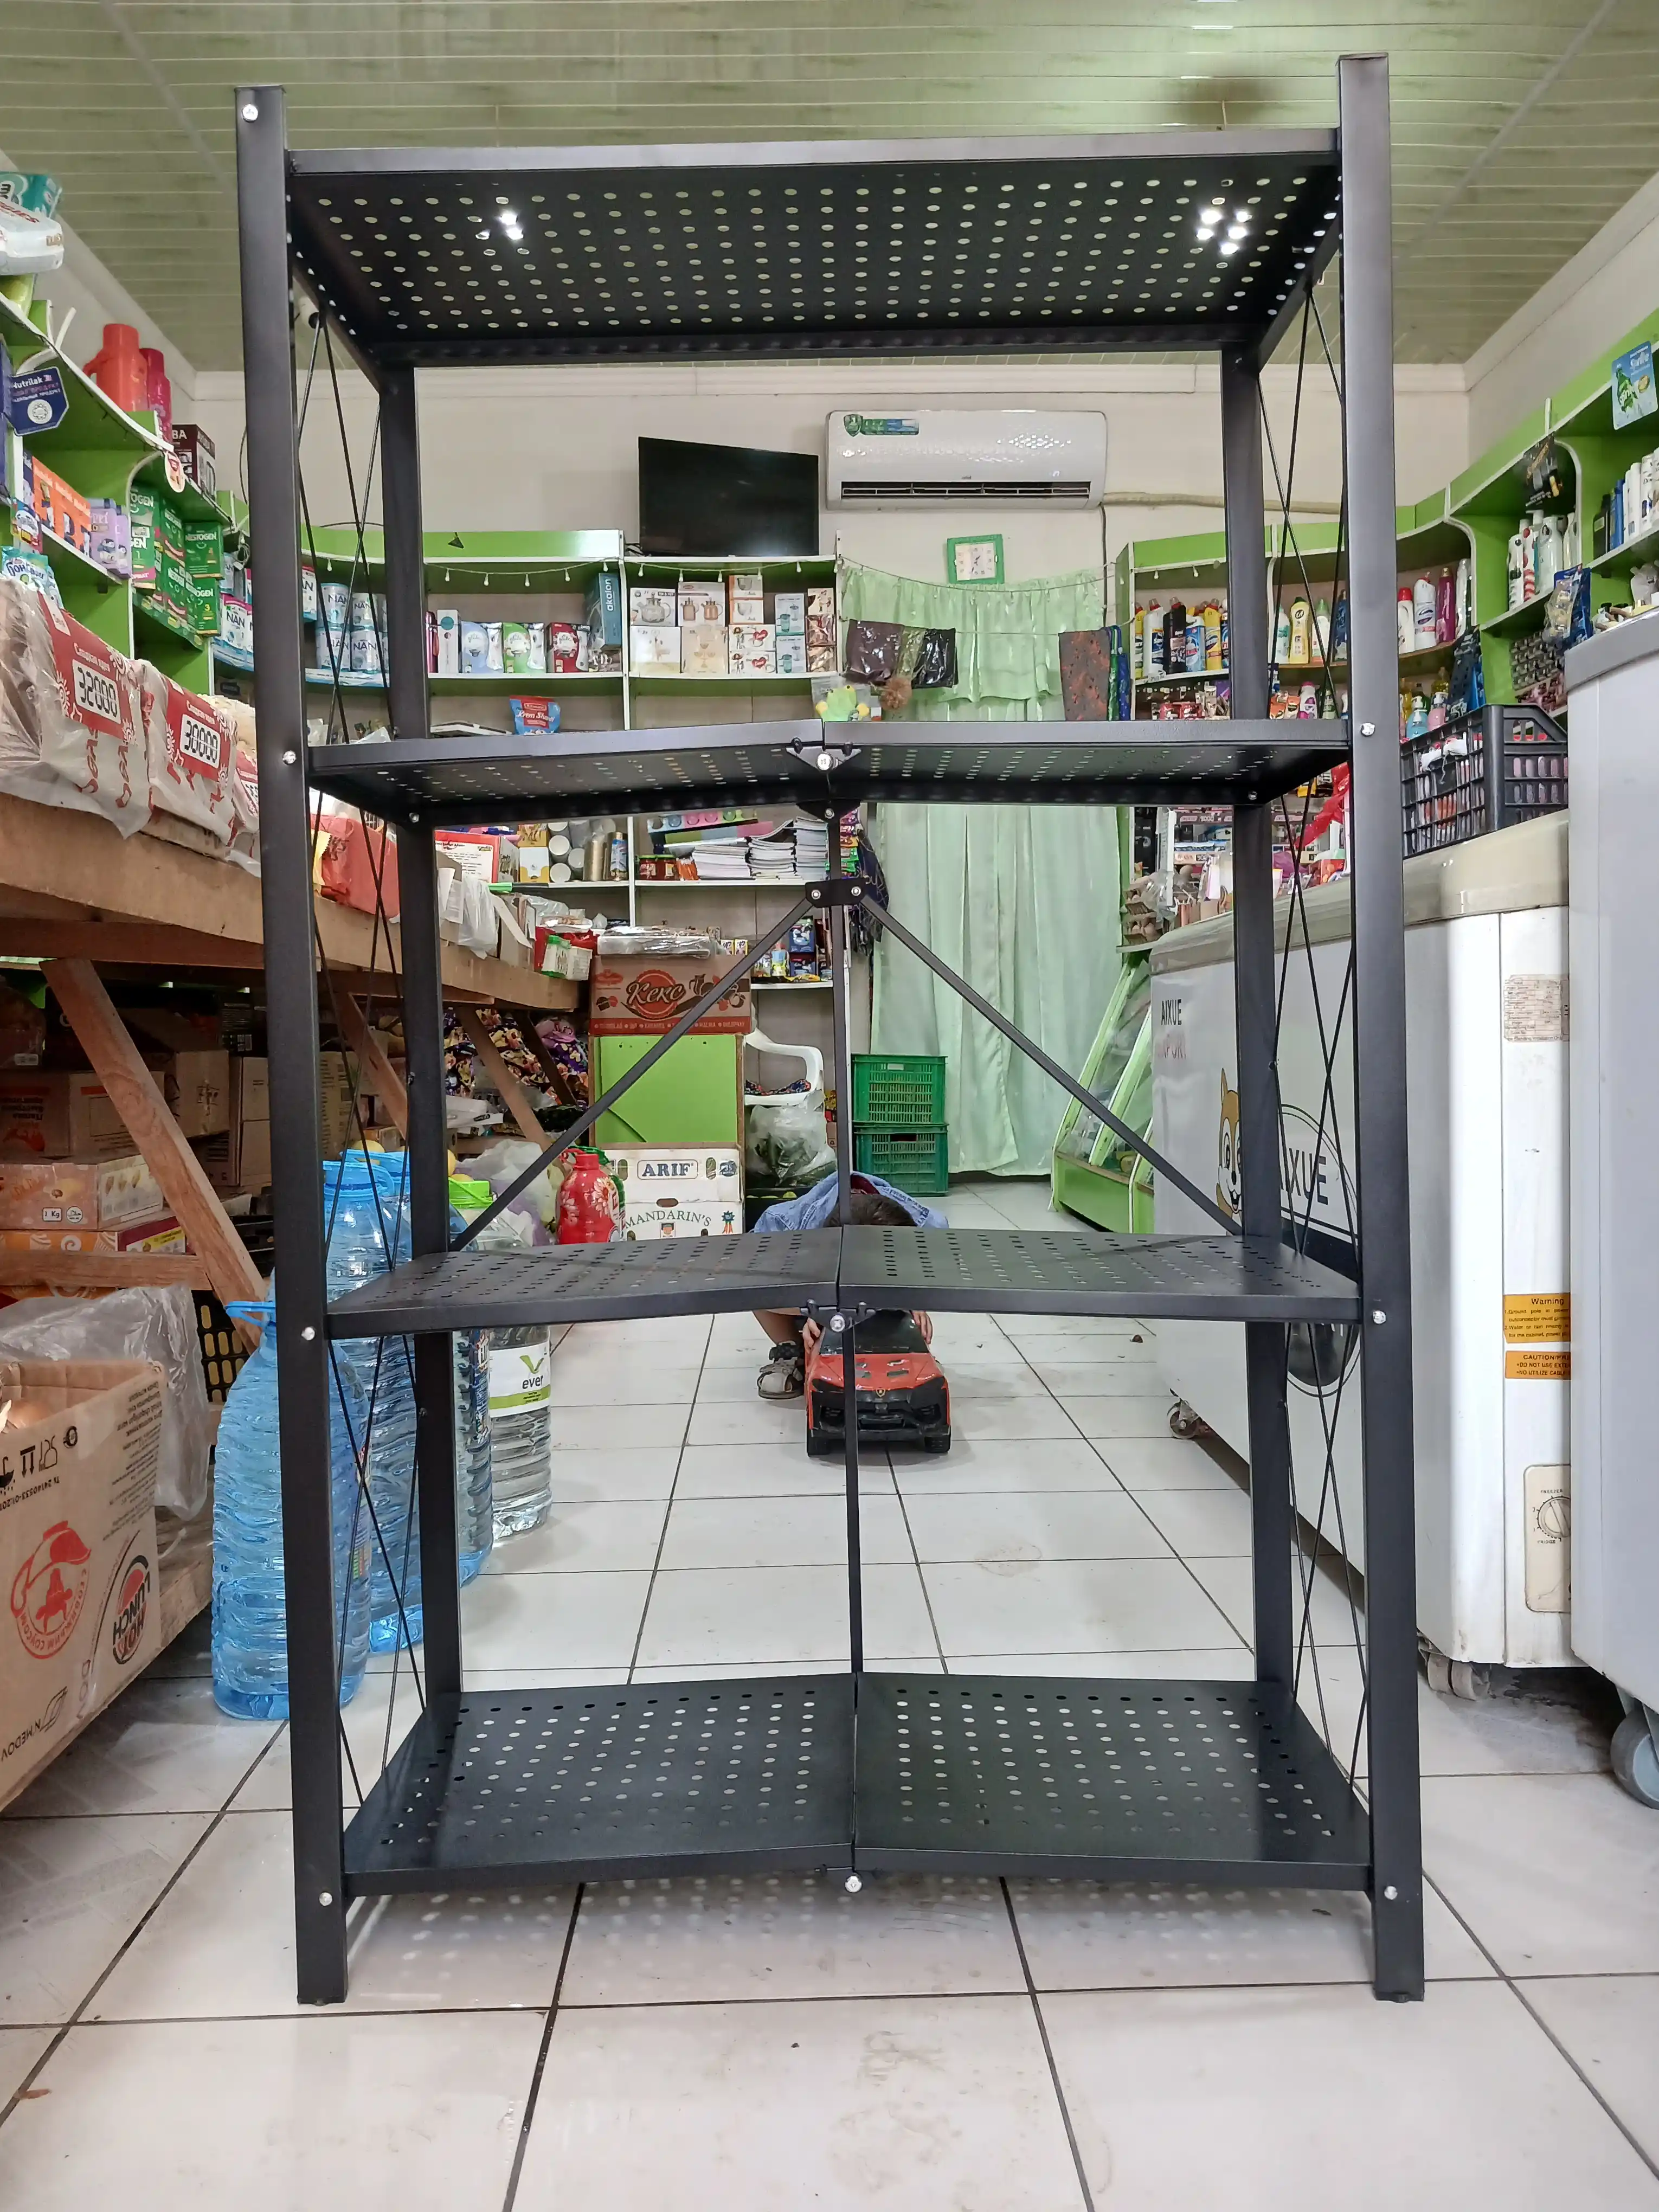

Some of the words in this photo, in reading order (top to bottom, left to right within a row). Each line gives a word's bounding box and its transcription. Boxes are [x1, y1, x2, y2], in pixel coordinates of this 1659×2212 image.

[226, 612, 245, 627] NAN
[353, 642, 376, 650] NAN
[626, 981, 685, 1004] Кекс
[1161, 999, 1182, 1025] AIXUE
[642, 1162, 691, 1177] ARIF
[51, 1211, 60, 1219] Kg
[623, 1210, 711, 1229] MANDARIN'S
[1531, 1297, 1564, 1306] Warning
[112, 1571, 151, 1645] LUNCH
